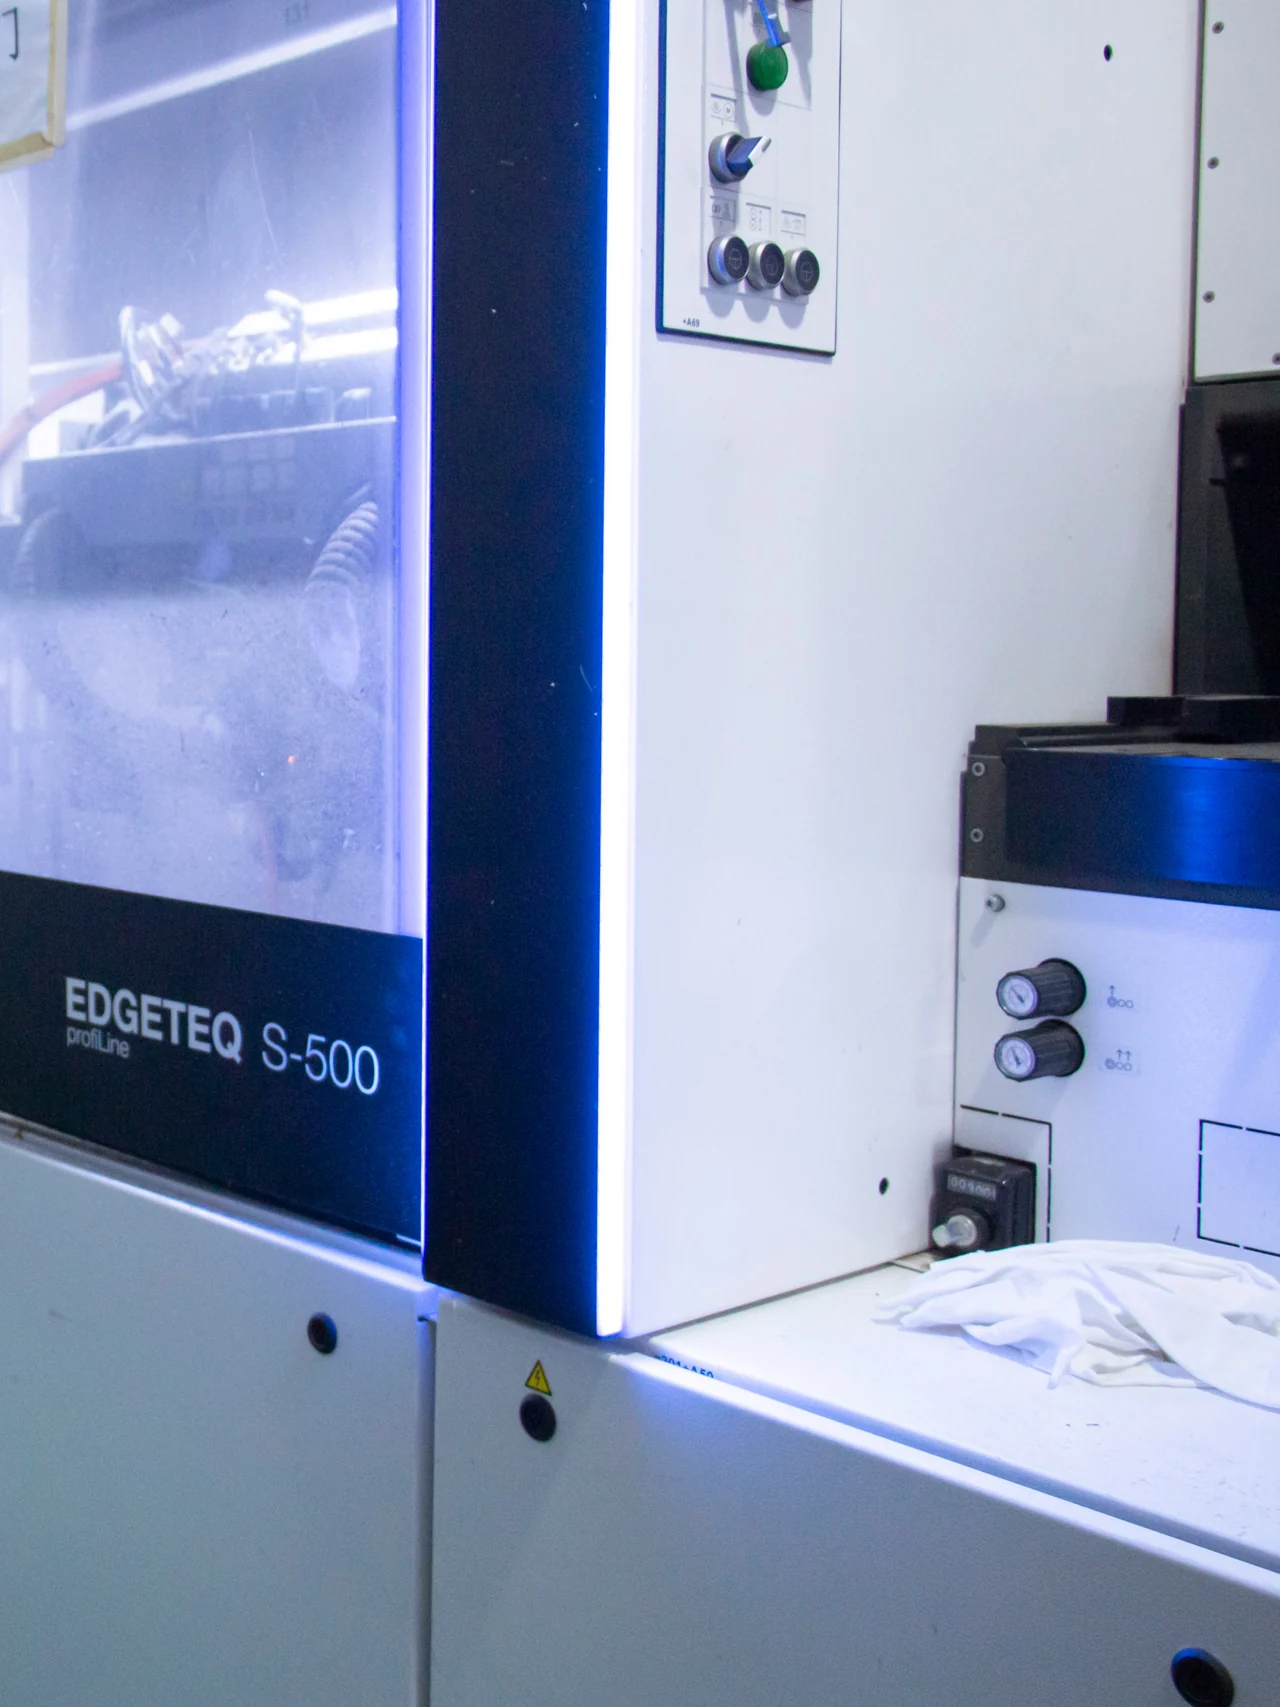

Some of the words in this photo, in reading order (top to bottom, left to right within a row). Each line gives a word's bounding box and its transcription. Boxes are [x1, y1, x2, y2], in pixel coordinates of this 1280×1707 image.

[65, 977, 242, 1064] EDGETEQ
[262, 1022, 380, 1095] S-500
[66, 1025, 130, 1058] profiLine
